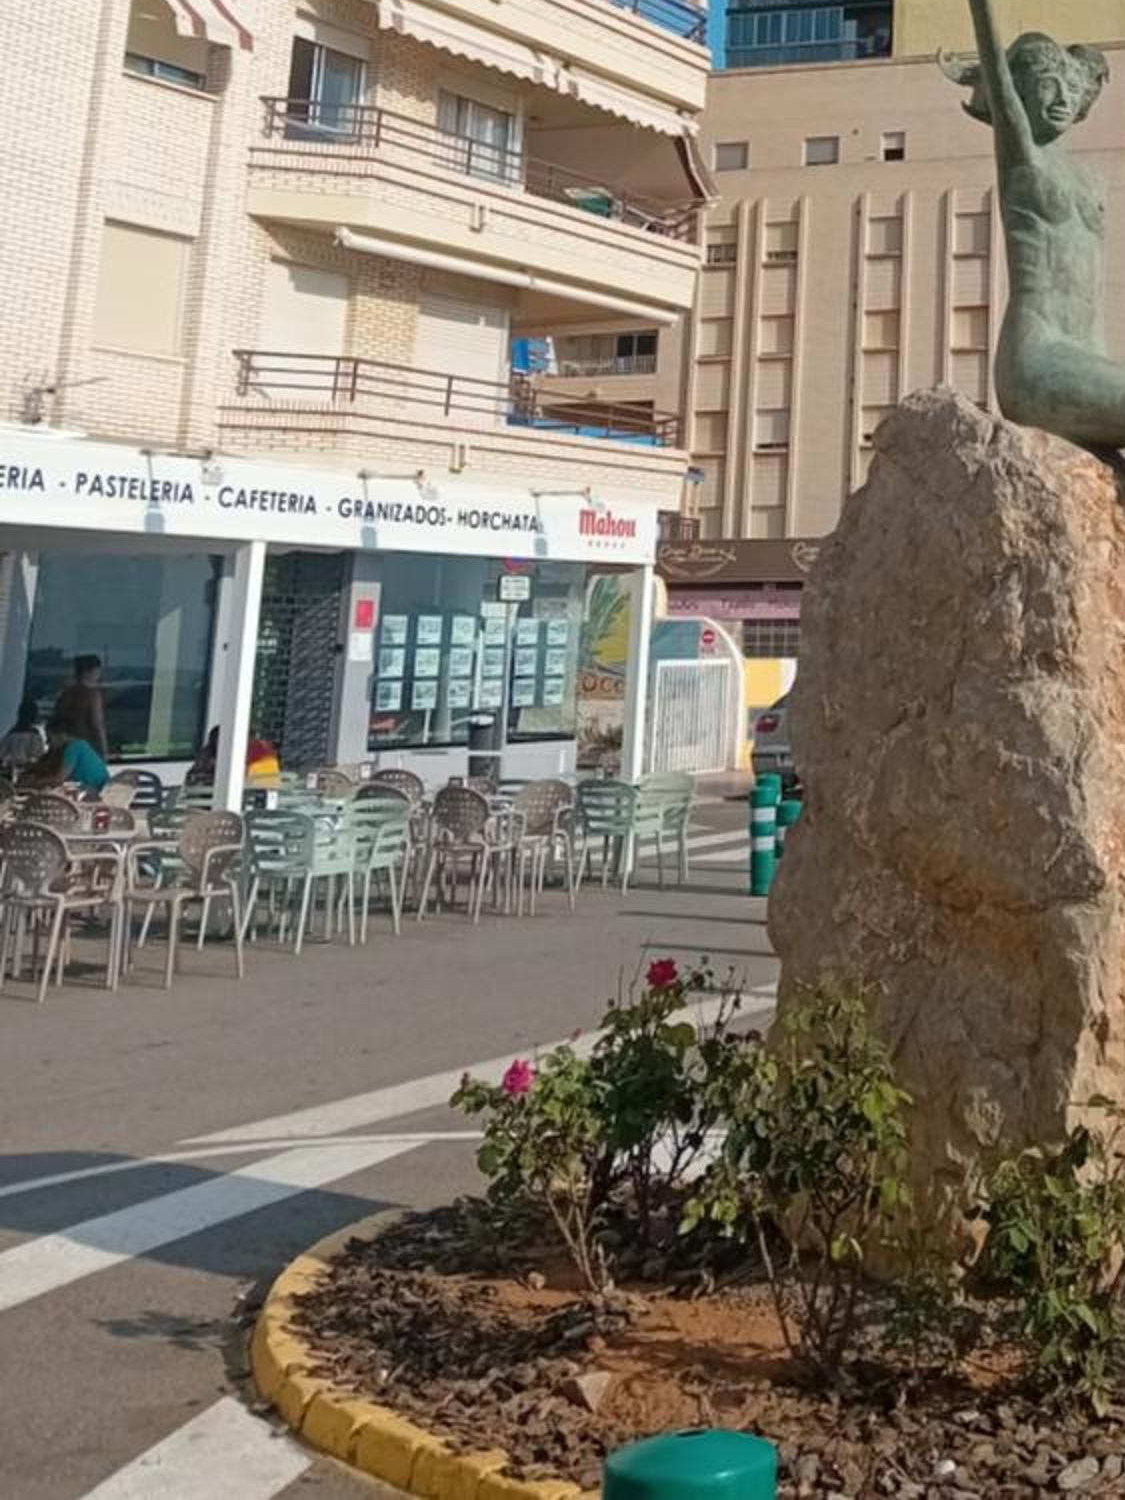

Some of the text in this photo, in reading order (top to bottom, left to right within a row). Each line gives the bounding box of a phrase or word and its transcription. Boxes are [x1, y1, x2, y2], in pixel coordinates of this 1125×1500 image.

[75, 471, 195, 503] PASTELERIA
[218, 486, 318, 514] CAFETERIA
[457, 510, 539, 533] HORCHATA
[579, 509, 637, 537] Mahou
